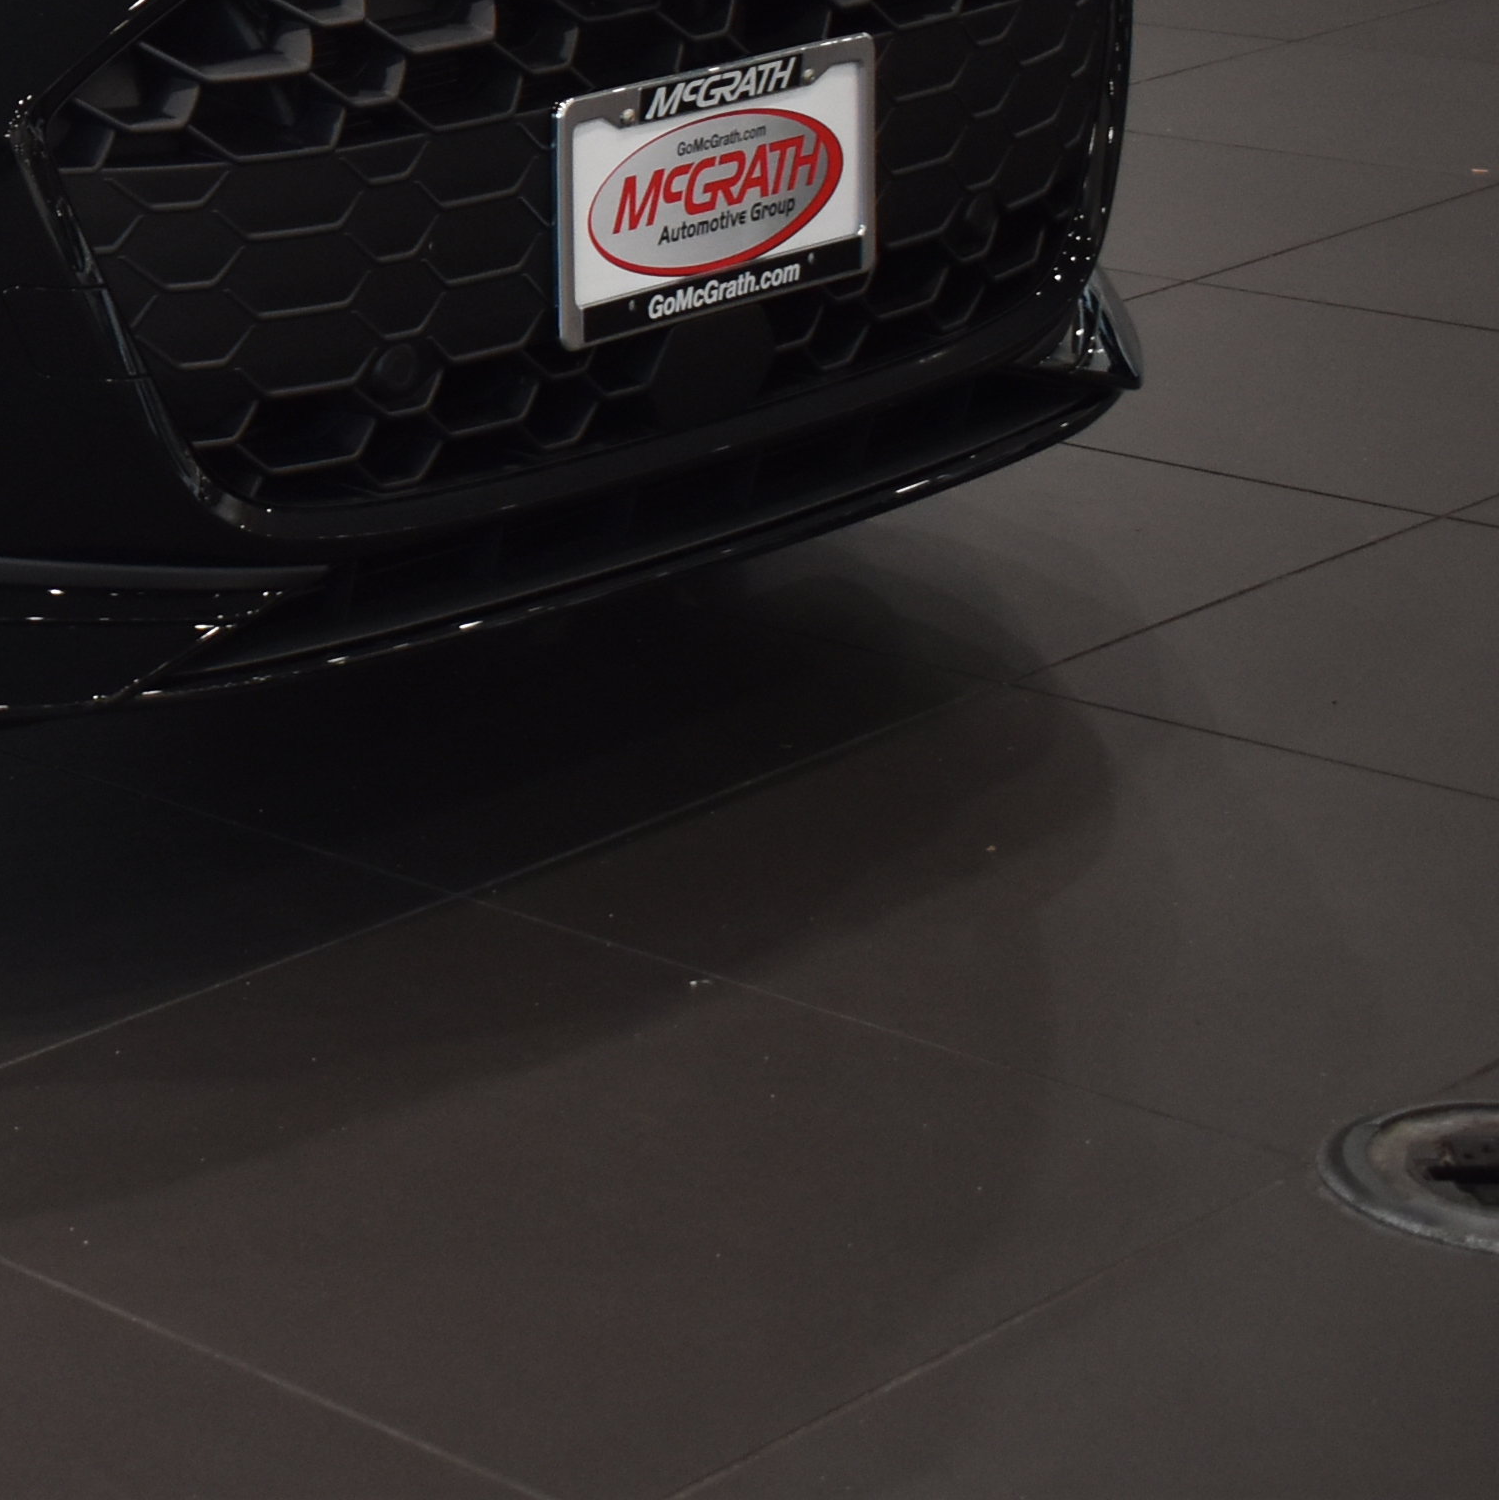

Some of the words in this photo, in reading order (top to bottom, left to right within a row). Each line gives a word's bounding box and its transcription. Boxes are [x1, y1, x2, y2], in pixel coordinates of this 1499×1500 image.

[677, 123, 767, 157] GoMcGrath.com
[657, 209, 747, 246] Automotive
[750, 196, 796, 223] Group
[647, 261, 801, 320] GoMcGrath.com
